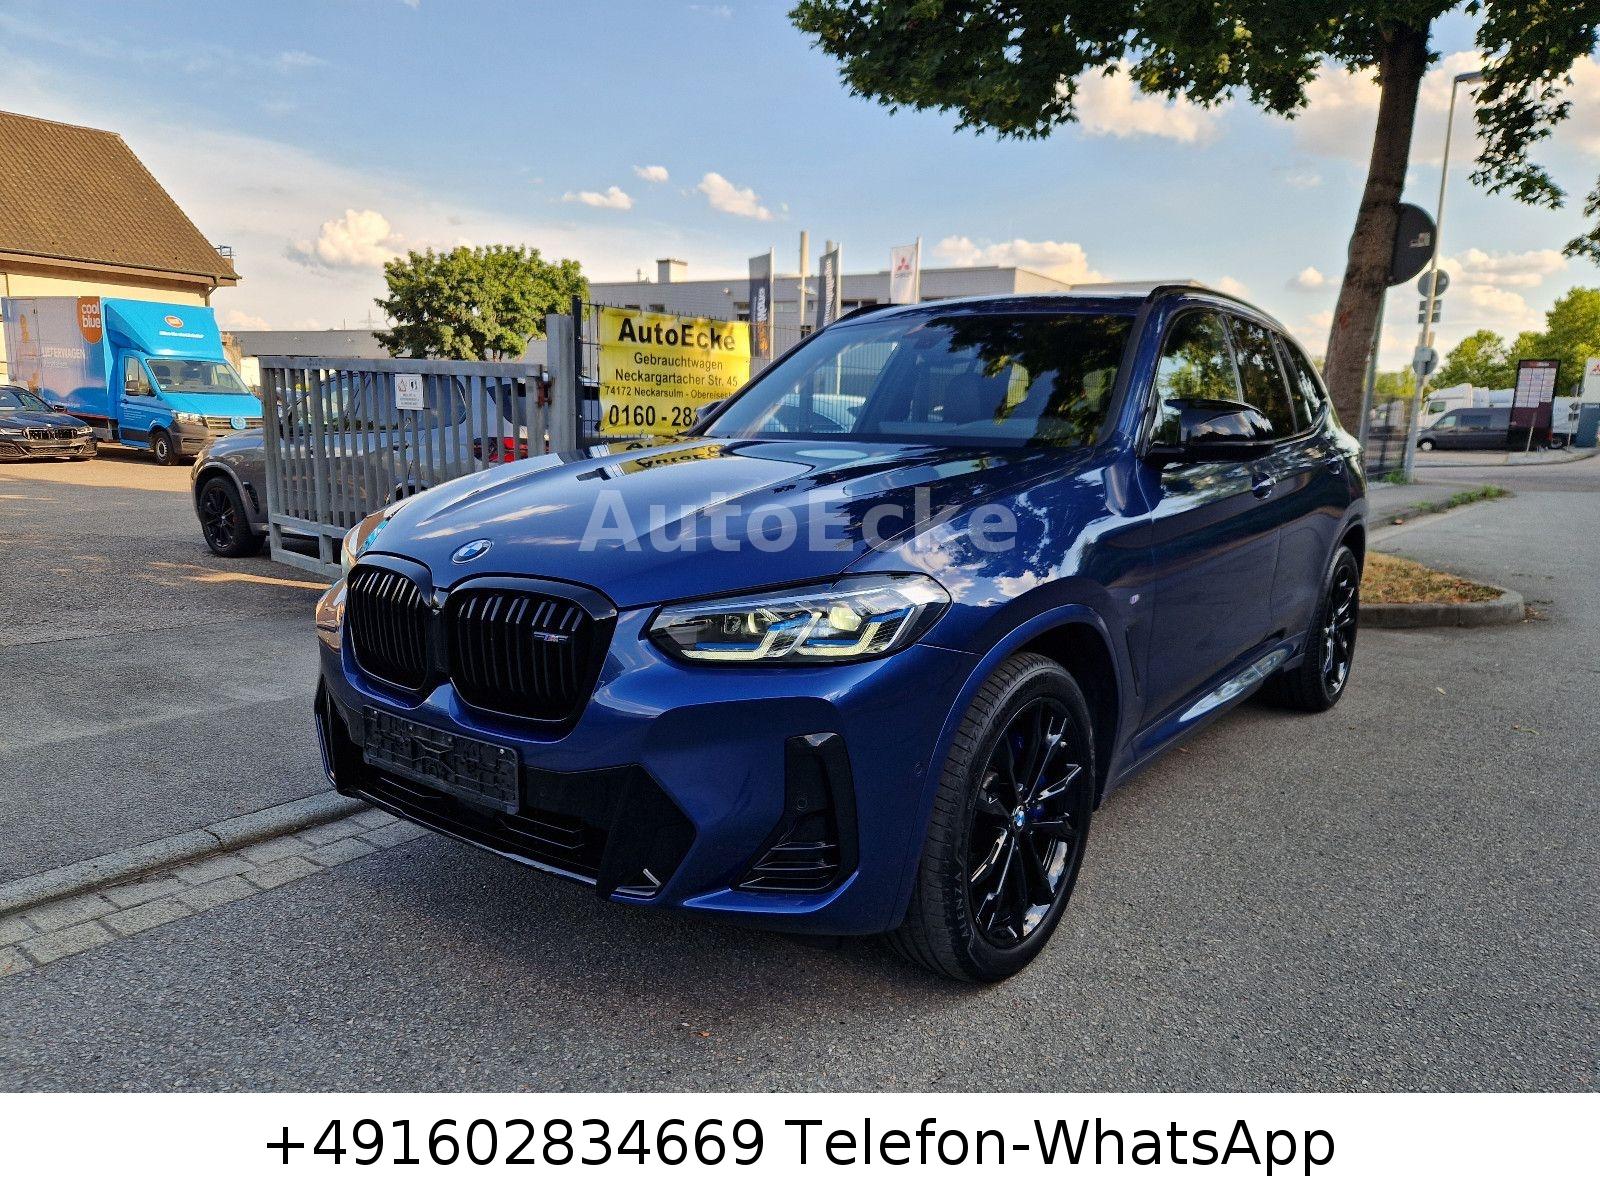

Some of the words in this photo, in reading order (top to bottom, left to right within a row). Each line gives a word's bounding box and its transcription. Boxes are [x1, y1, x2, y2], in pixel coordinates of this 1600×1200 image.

[82, 301, 100, 315] cool
[83, 314, 101, 329] blue
[618, 318, 736, 350] AutoEcke
[634, 352, 723, 371] Gebrauchtwagen
[615, 368, 706, 387] Neckargartacher
[708, 374, 724, 387] Str.
[726, 376, 738, 387] 45
[605, 385, 631, 396] 74172
[634, 387, 684, 398] Neckarsulm
[608, 404, 656, 427] 0160
